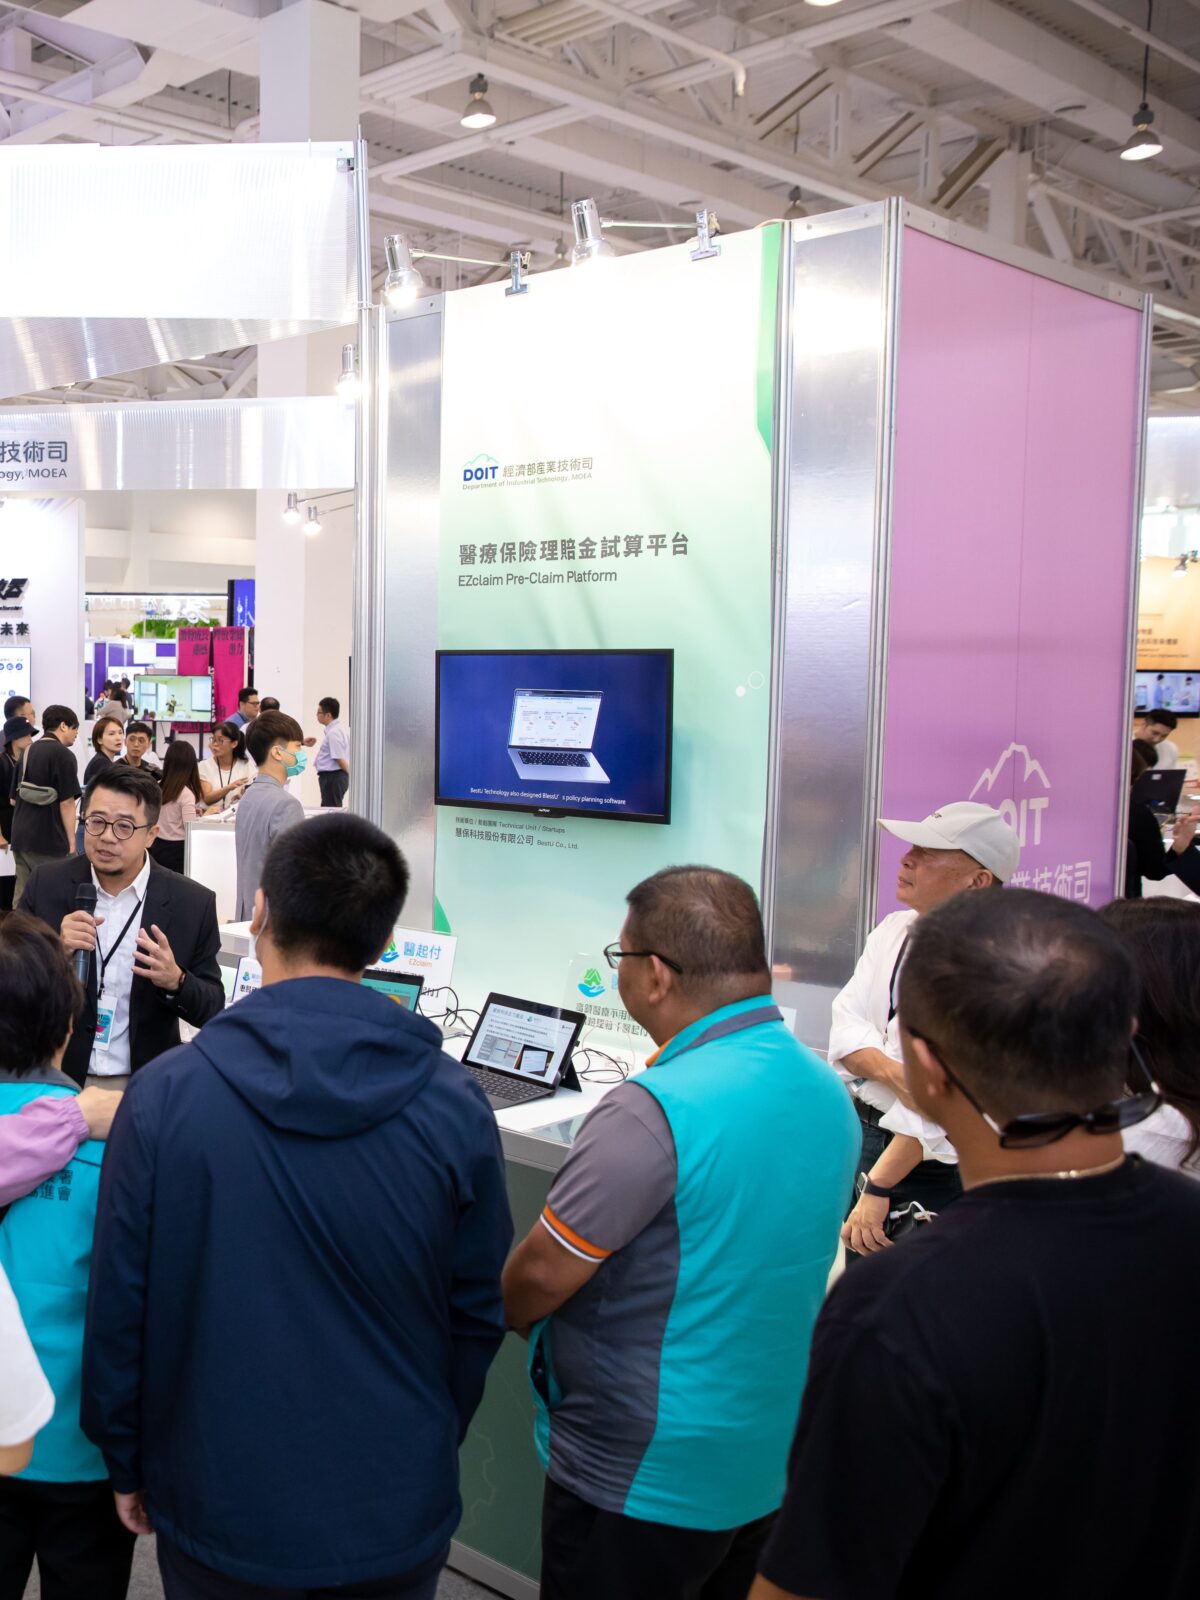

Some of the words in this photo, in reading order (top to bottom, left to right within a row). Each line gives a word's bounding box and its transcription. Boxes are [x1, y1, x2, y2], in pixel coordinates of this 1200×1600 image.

[28, 468, 68, 478] MOEA
[462, 482, 498, 491] Department
[506, 478, 536, 487] Industrial
[571, 472, 593, 480] MOEA
[463, 466, 499, 482] DOIT
[458, 531, 689, 566] 醫療保險理賠金試算平台
[458, 573, 504, 587] EZclaim
[506, 571, 564, 585] Pre-Claim
[566, 569, 618, 584] Platform
[484, 788, 510, 797] Technology
[520, 791, 542, 799] designed
[565, 794, 581, 803] policy
[581, 795, 604, 805] planning
[604, 797, 627, 806] software
[498, 821, 524, 830] Technical
[525, 823, 537, 831] Unit
[542, 825, 566, 834] Startups
[985, 797, 1050, 847] OIT
